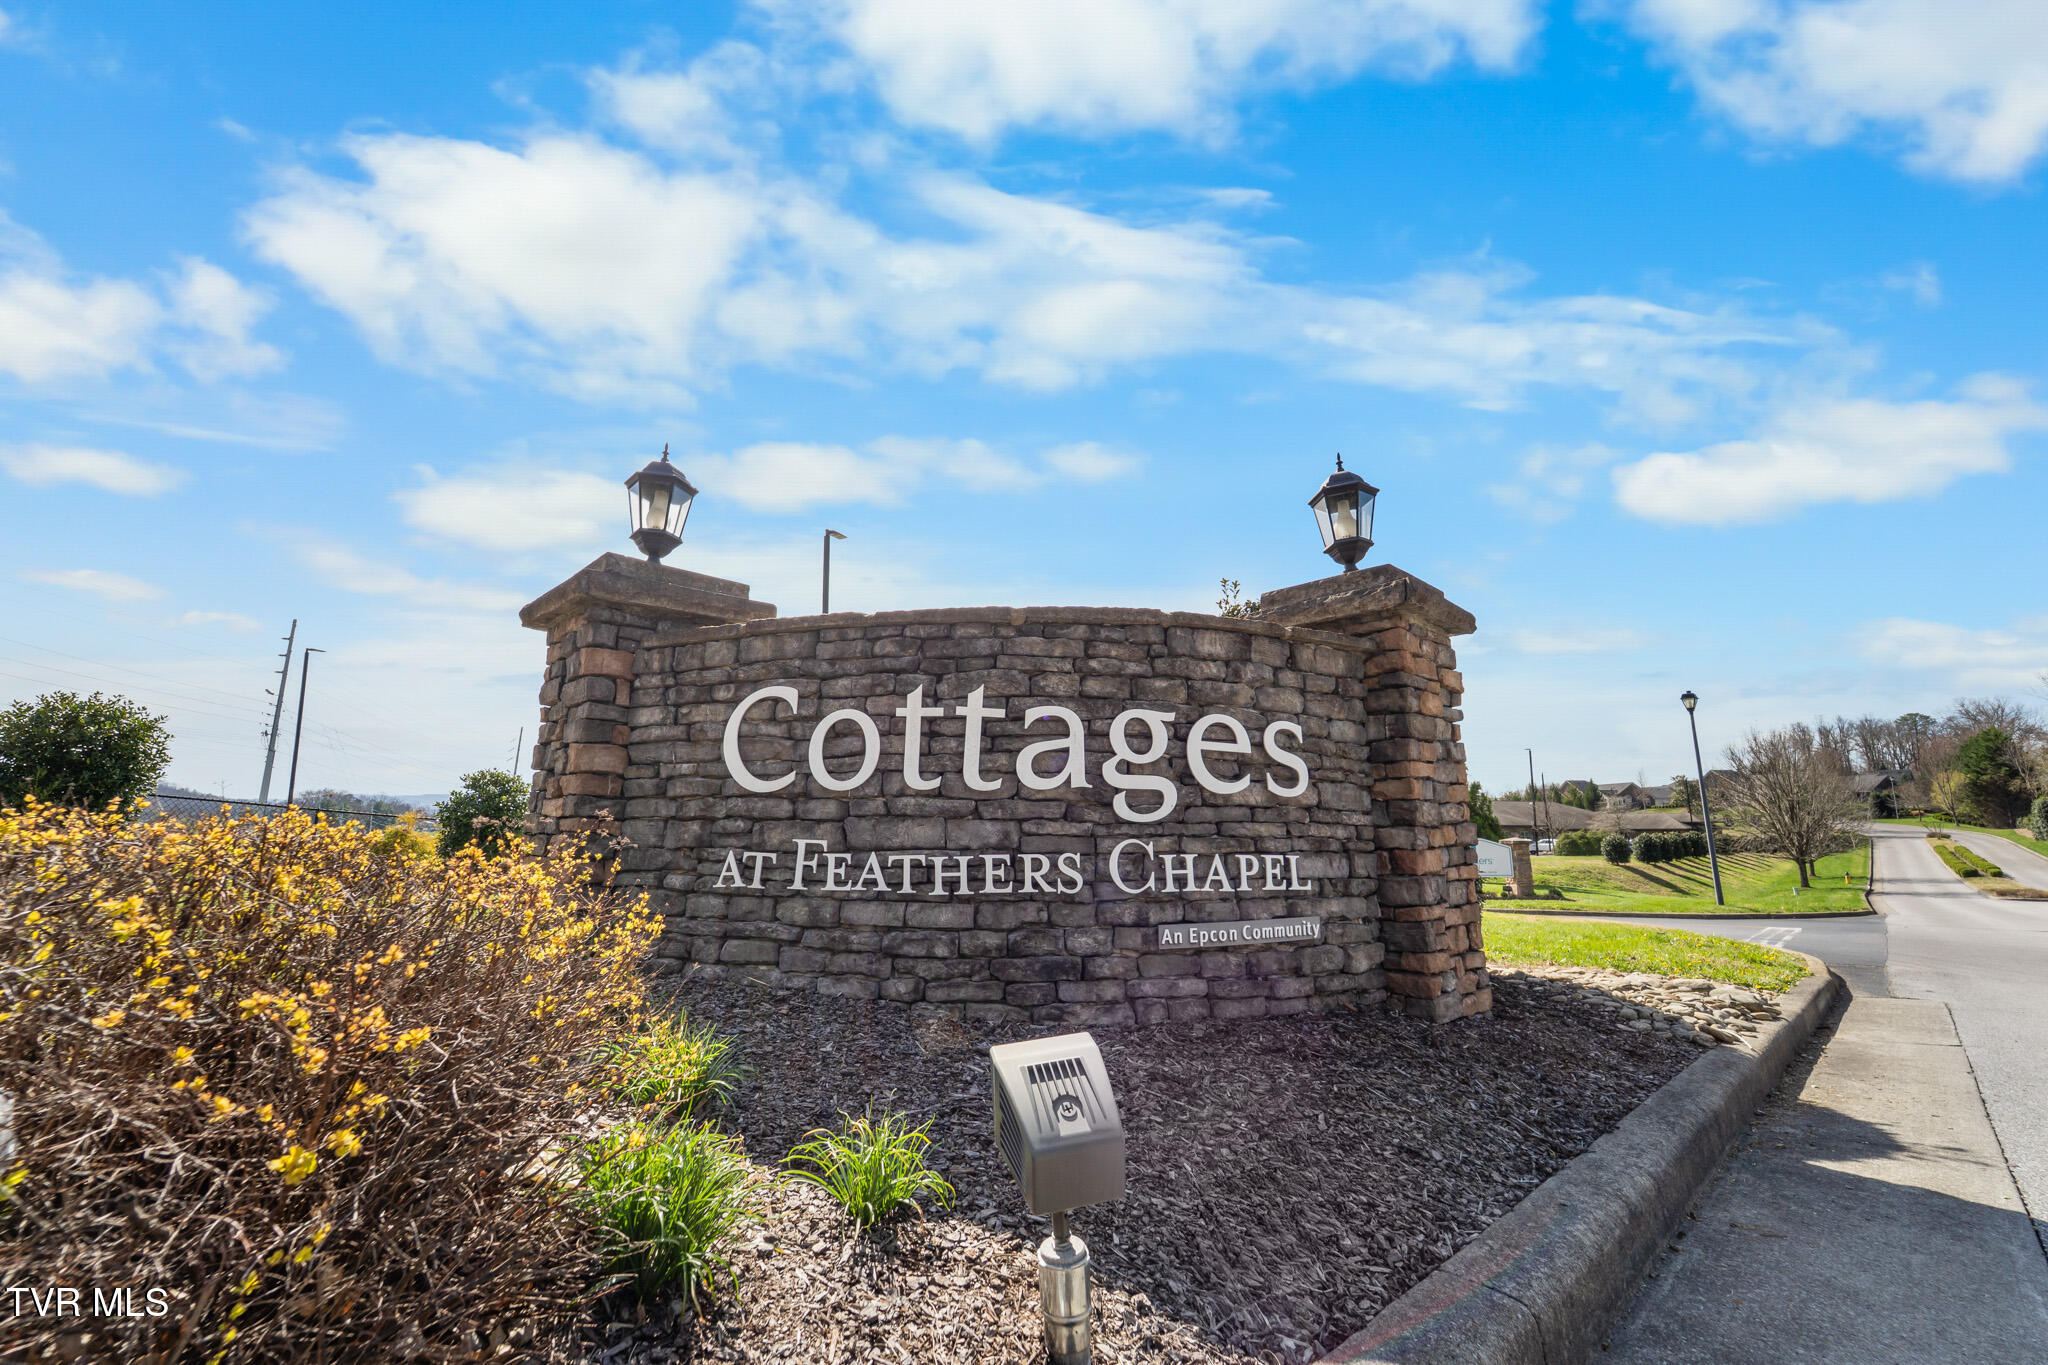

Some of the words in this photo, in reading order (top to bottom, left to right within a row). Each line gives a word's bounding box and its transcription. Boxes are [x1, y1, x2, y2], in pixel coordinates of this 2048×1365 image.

[723, 684, 1310, 823] Cottages
[713, 849, 778, 889] AT
[788, 838, 1084, 896] FEATHERS
[1108, 838, 1313, 895] CHAPEL
[1161, 928, 1183, 945] An
[1189, 927, 1238, 946] Epcon
[1242, 920, 1320, 940] Community
